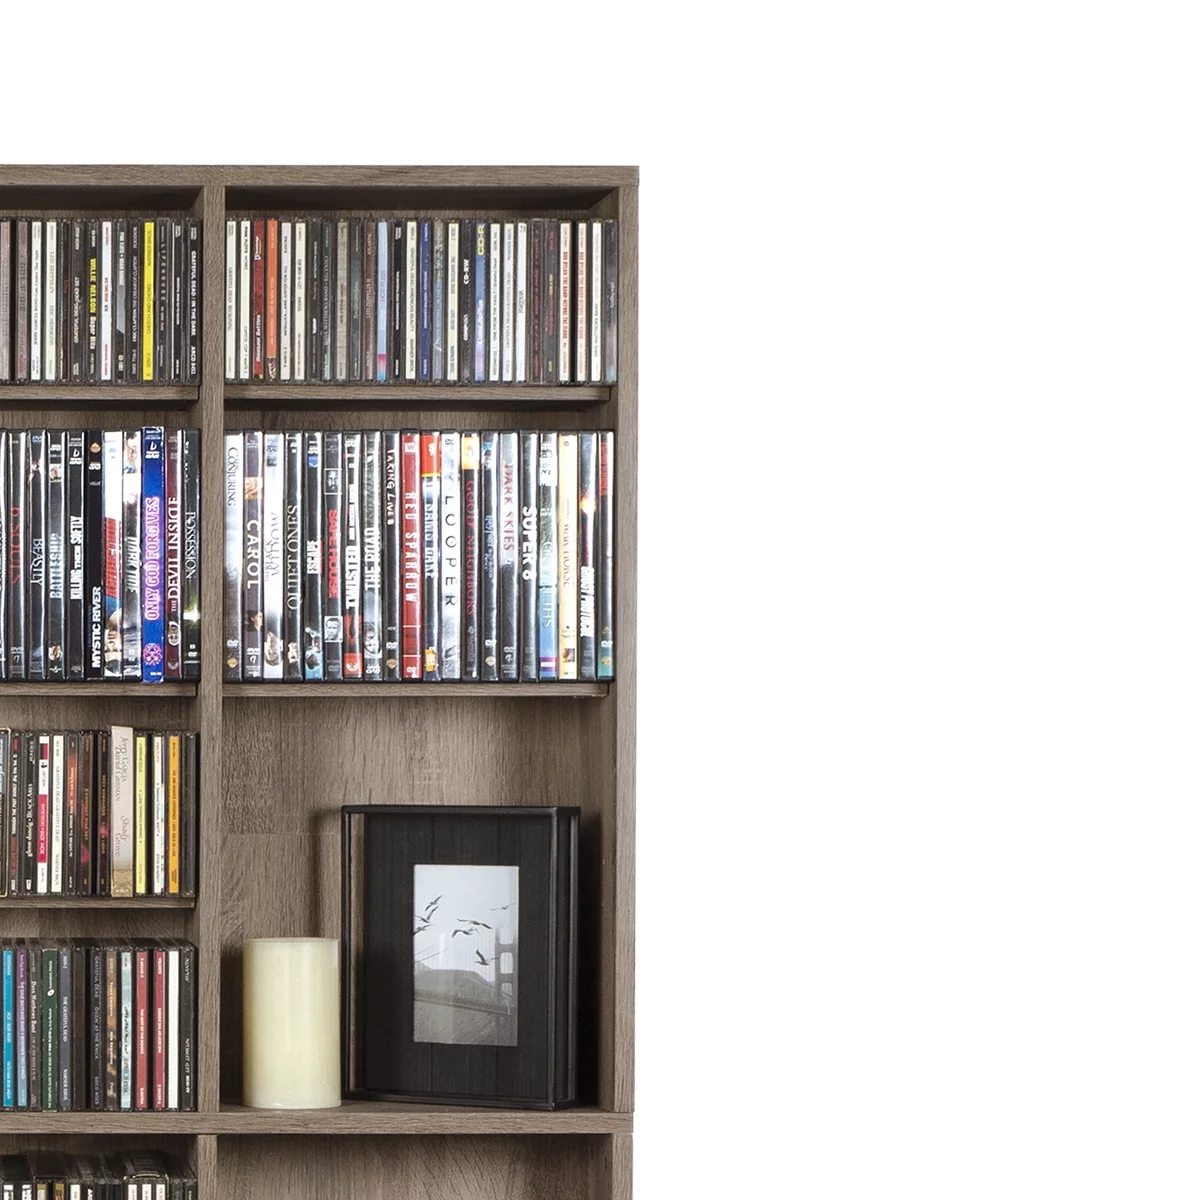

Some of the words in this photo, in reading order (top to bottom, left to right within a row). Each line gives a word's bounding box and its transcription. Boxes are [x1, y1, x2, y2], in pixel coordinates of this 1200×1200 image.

[168, 497, 178, 552] INSIDE
[287, 505, 298, 552] ONES
[405, 492, 415, 519] RED
[247, 519, 259, 589] CAROL
[445, 496, 456, 606] LOOPER
[522, 506, 535, 565] SUPER
[30, 538, 42, 586] BEASTLY
[168, 555, 178, 599] DEVIL
[405, 532, 416, 603] SPARROW
[93, 586, 101, 621] RIVER
[92, 624, 101, 667] MYSTIC
